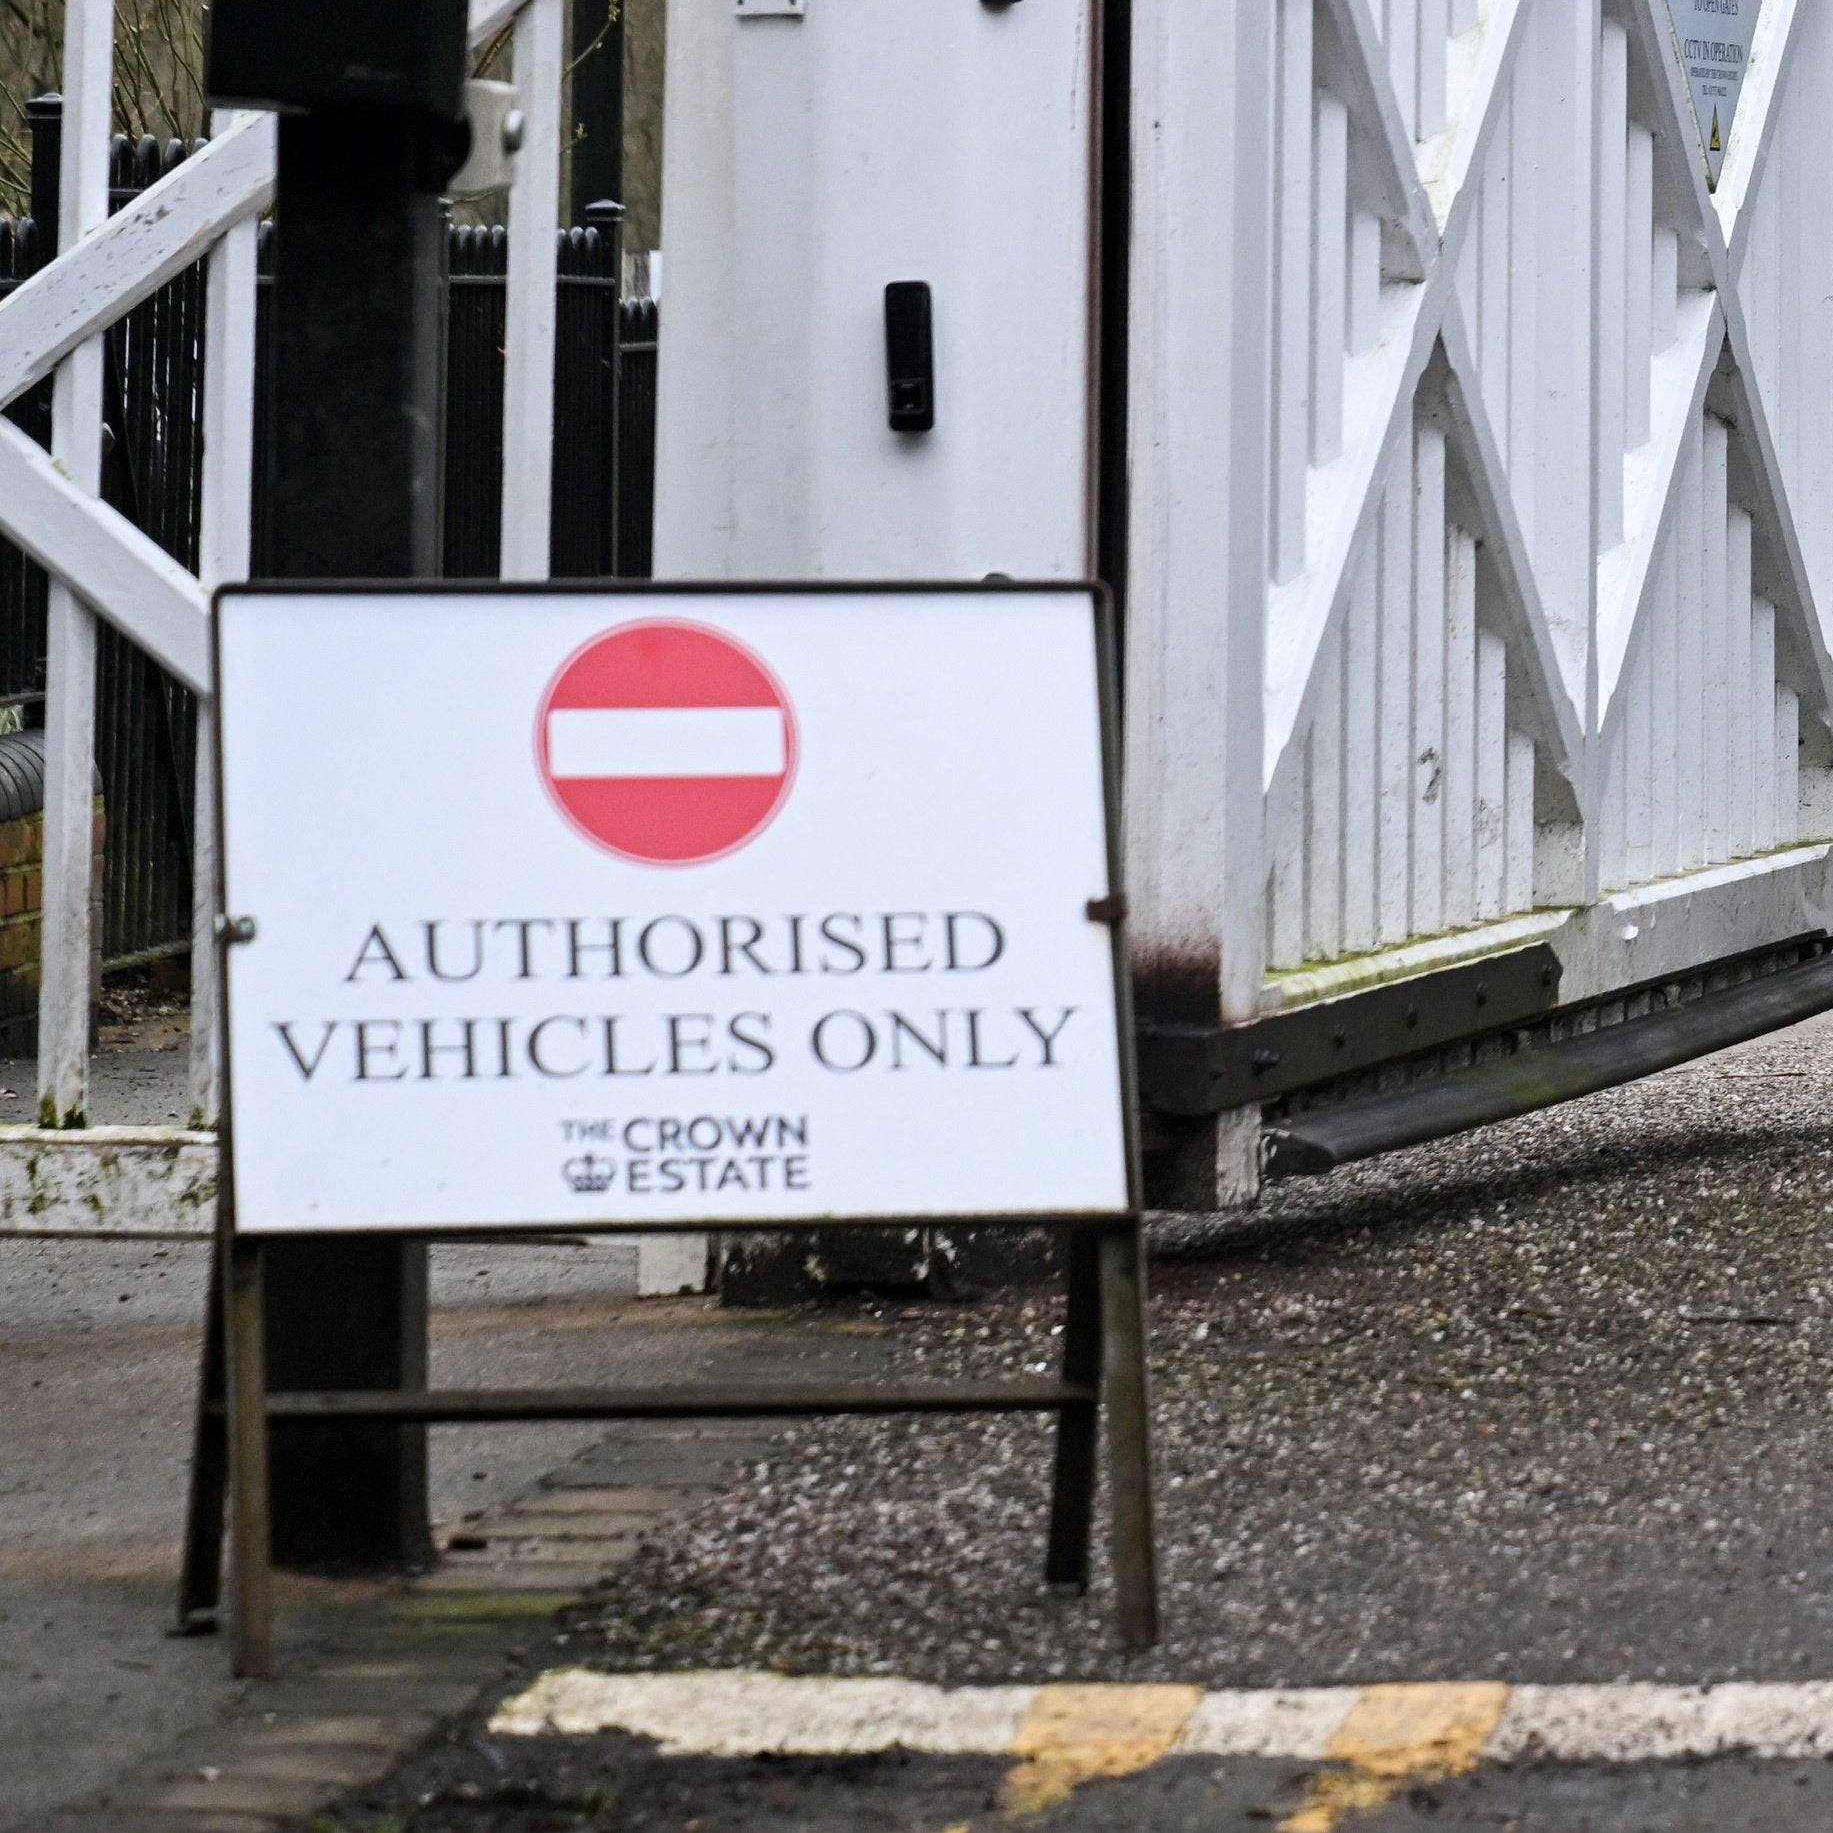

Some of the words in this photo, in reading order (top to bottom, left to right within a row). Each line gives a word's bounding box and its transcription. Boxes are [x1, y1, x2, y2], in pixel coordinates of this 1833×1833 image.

[1684, 38, 1702, 60] CCTV
[1702, 40, 1710, 60] IN
[1710, 41, 1744, 63] OPERATION
[343, 910, 1009, 984] AUTHORISED
[270, 1009, 777, 1083] VEHICLES
[811, 1003, 1081, 1075] ONLY
[560, 1119, 615, 1142] THE
[623, 1115, 808, 1153] CROWN
[627, 1154, 812, 1193] ESTATE
